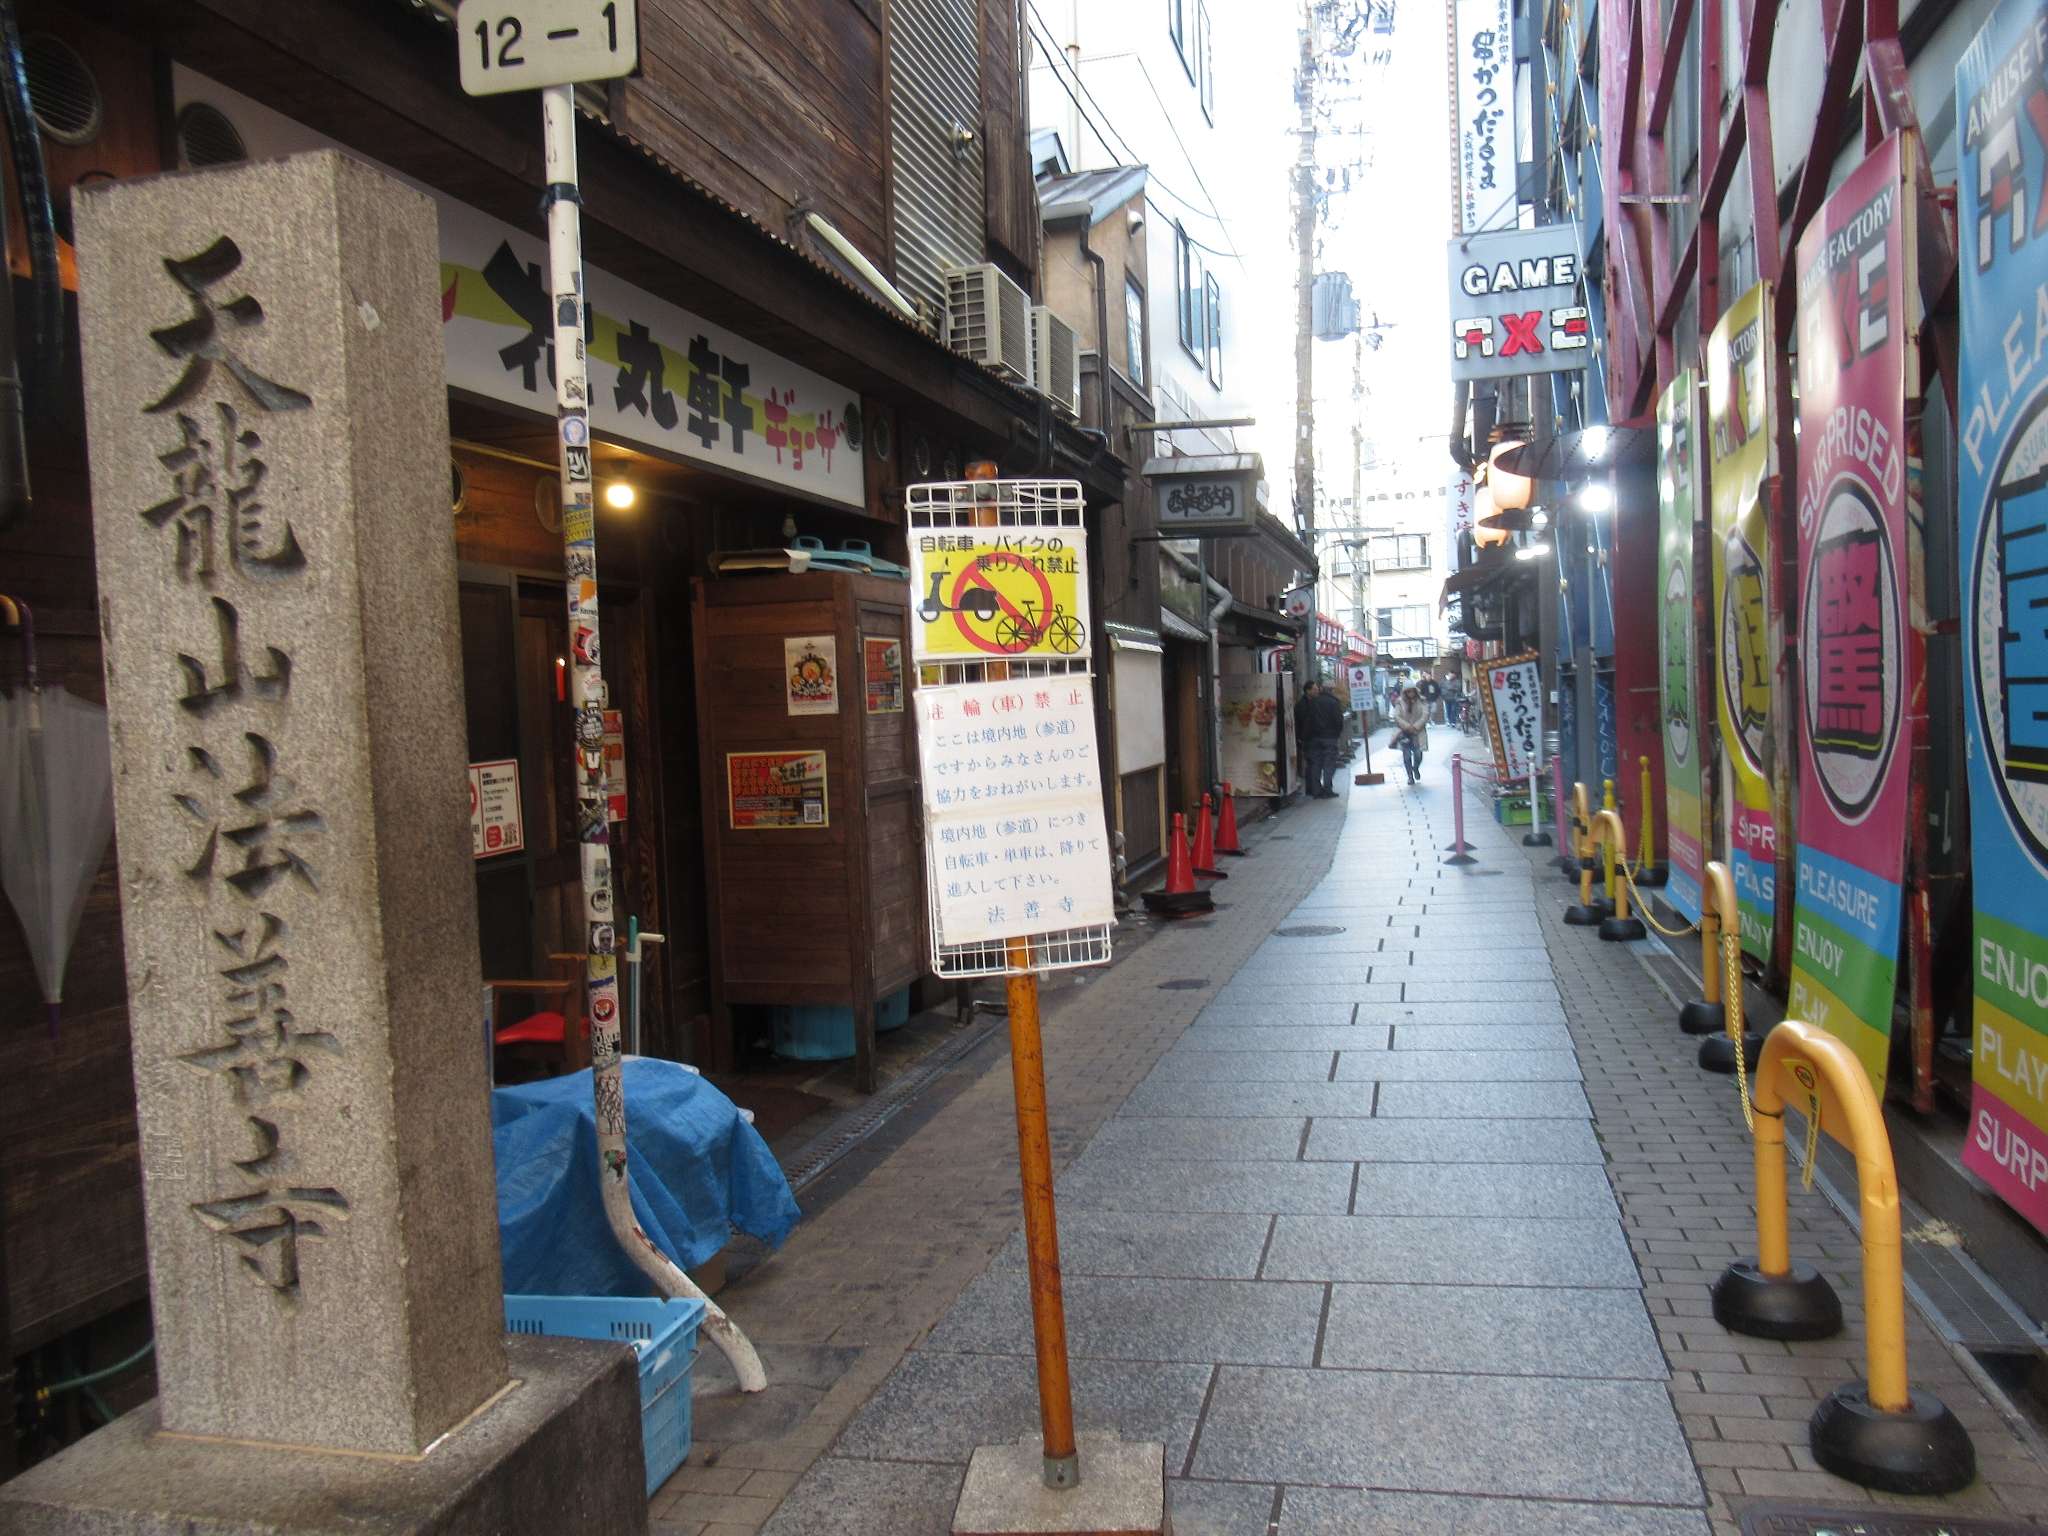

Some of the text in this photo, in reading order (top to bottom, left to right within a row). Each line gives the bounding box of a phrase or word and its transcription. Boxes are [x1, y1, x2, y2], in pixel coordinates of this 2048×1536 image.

[1472, 28, 1504, 189] 串かつだるま
[1967, 38, 2032, 146] AMUSE
[1828, 190, 1894, 264] FACTORY
[1462, 254, 1576, 297] GAME
[1454, 306, 1588, 360] AXE
[1800, 405, 1900, 538] SURPRISED
[920, 534, 1063, 553] 自転車・バイクの
[976, 555, 1081, 575] 乗り入れ禁止
[934, 744, 1090, 776] ですからみなさんのご
[936, 772, 1093, 805] 協力をおねがいします。
[946, 874, 1061, 898] 進入して下さい。
[1800, 861, 1880, 930] PLEASURE
[1797, 919, 1844, 978] ENJOY
[1794, 979, 1829, 1027] PLAY
